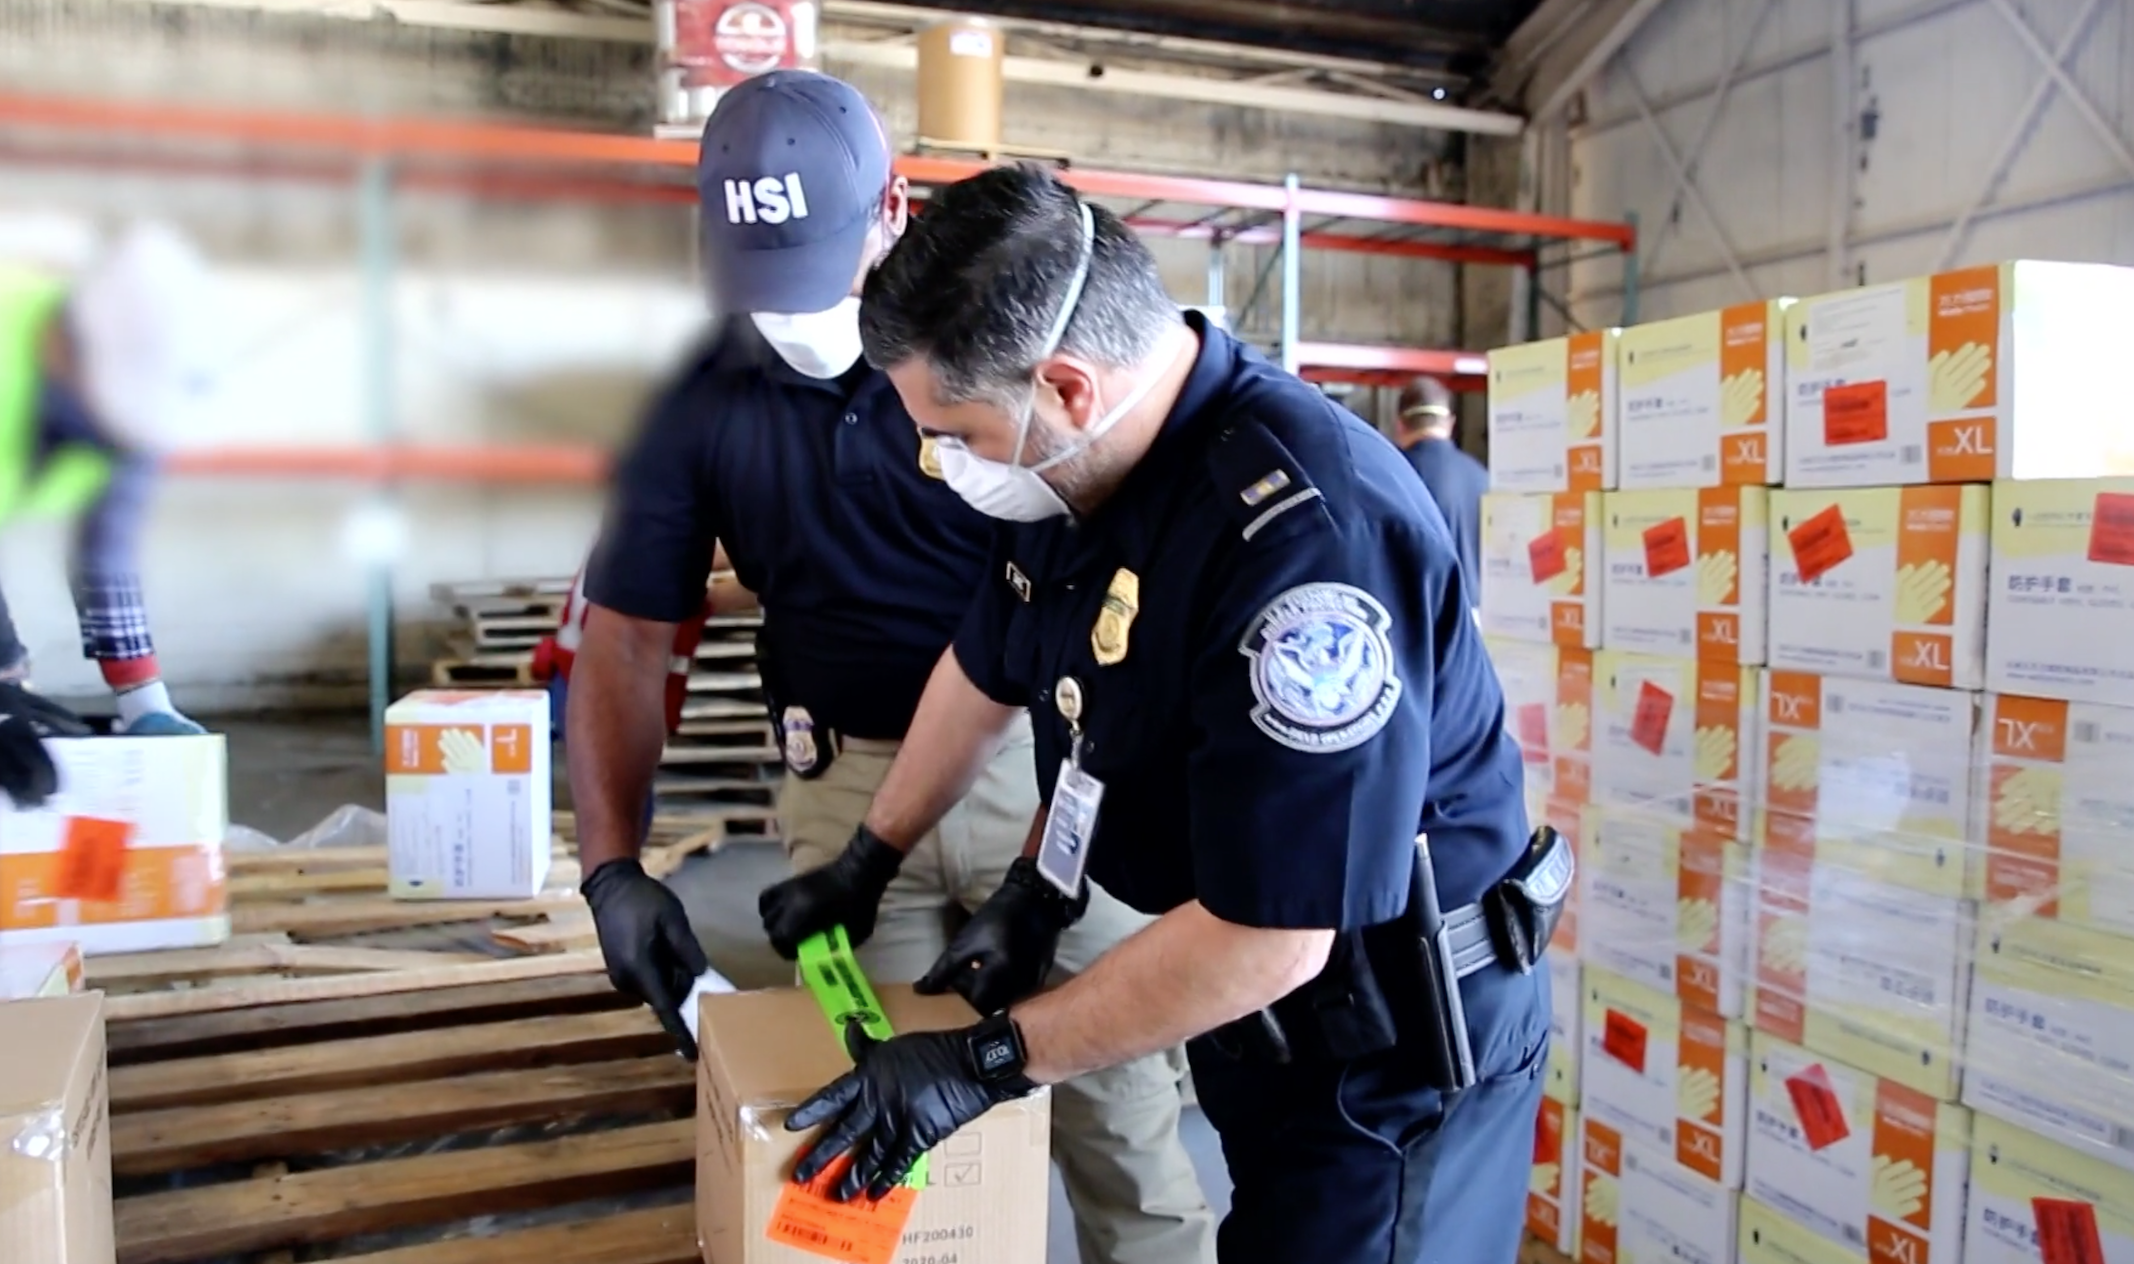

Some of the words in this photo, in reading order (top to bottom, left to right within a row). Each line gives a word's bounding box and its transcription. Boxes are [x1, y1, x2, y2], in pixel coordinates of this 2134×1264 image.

[724, 172, 808, 224] HSI
[1738, 440, 1766, 464] XL
[1953, 426, 1994, 455] XL
[1712, 619, 1738, 645] XL
[1914, 639, 1950, 671] XL
[1772, 693, 1801, 721] XL
[1998, 718, 2036, 750] XL
[1693, 1131, 1720, 1164] XL
